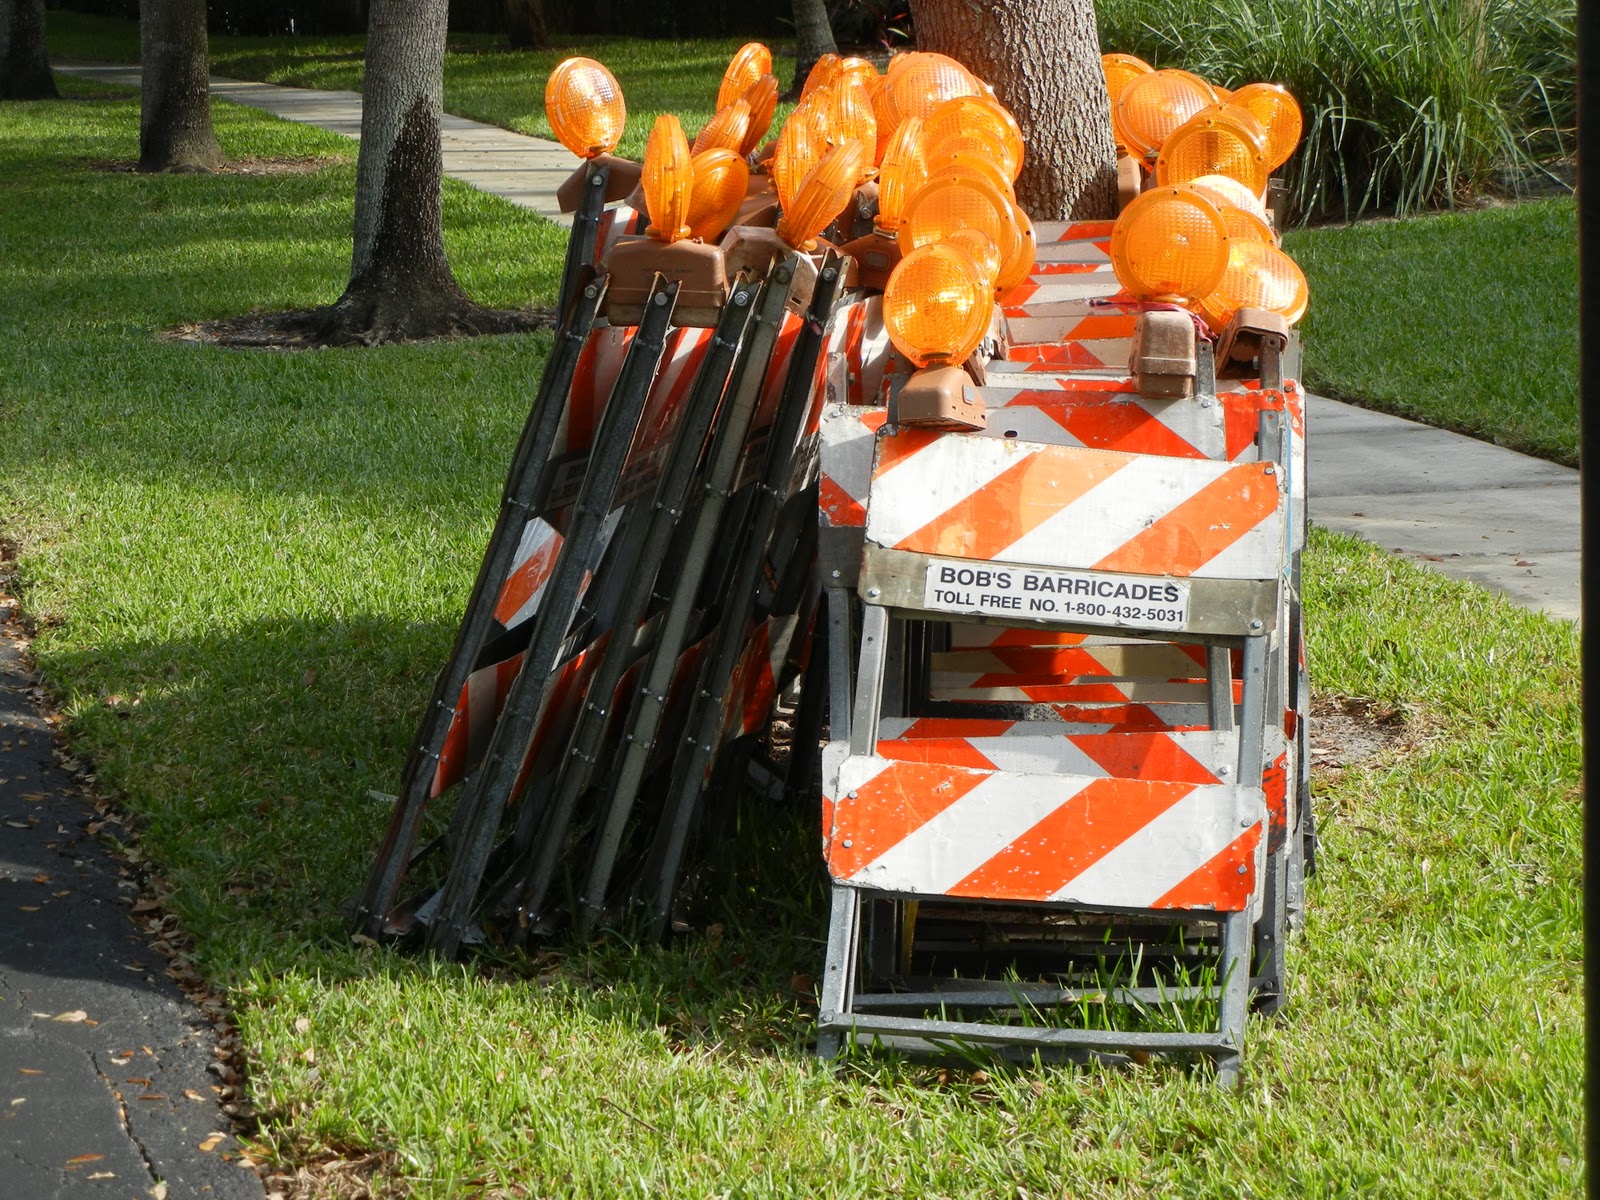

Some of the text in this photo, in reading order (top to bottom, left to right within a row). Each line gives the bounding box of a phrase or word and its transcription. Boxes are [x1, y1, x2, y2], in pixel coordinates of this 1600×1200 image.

[940, 566, 1180, 603] BOB'S BARRICADES
[934, 589, 1184, 623] TOLL FREE NO. 1-800-432-5031
